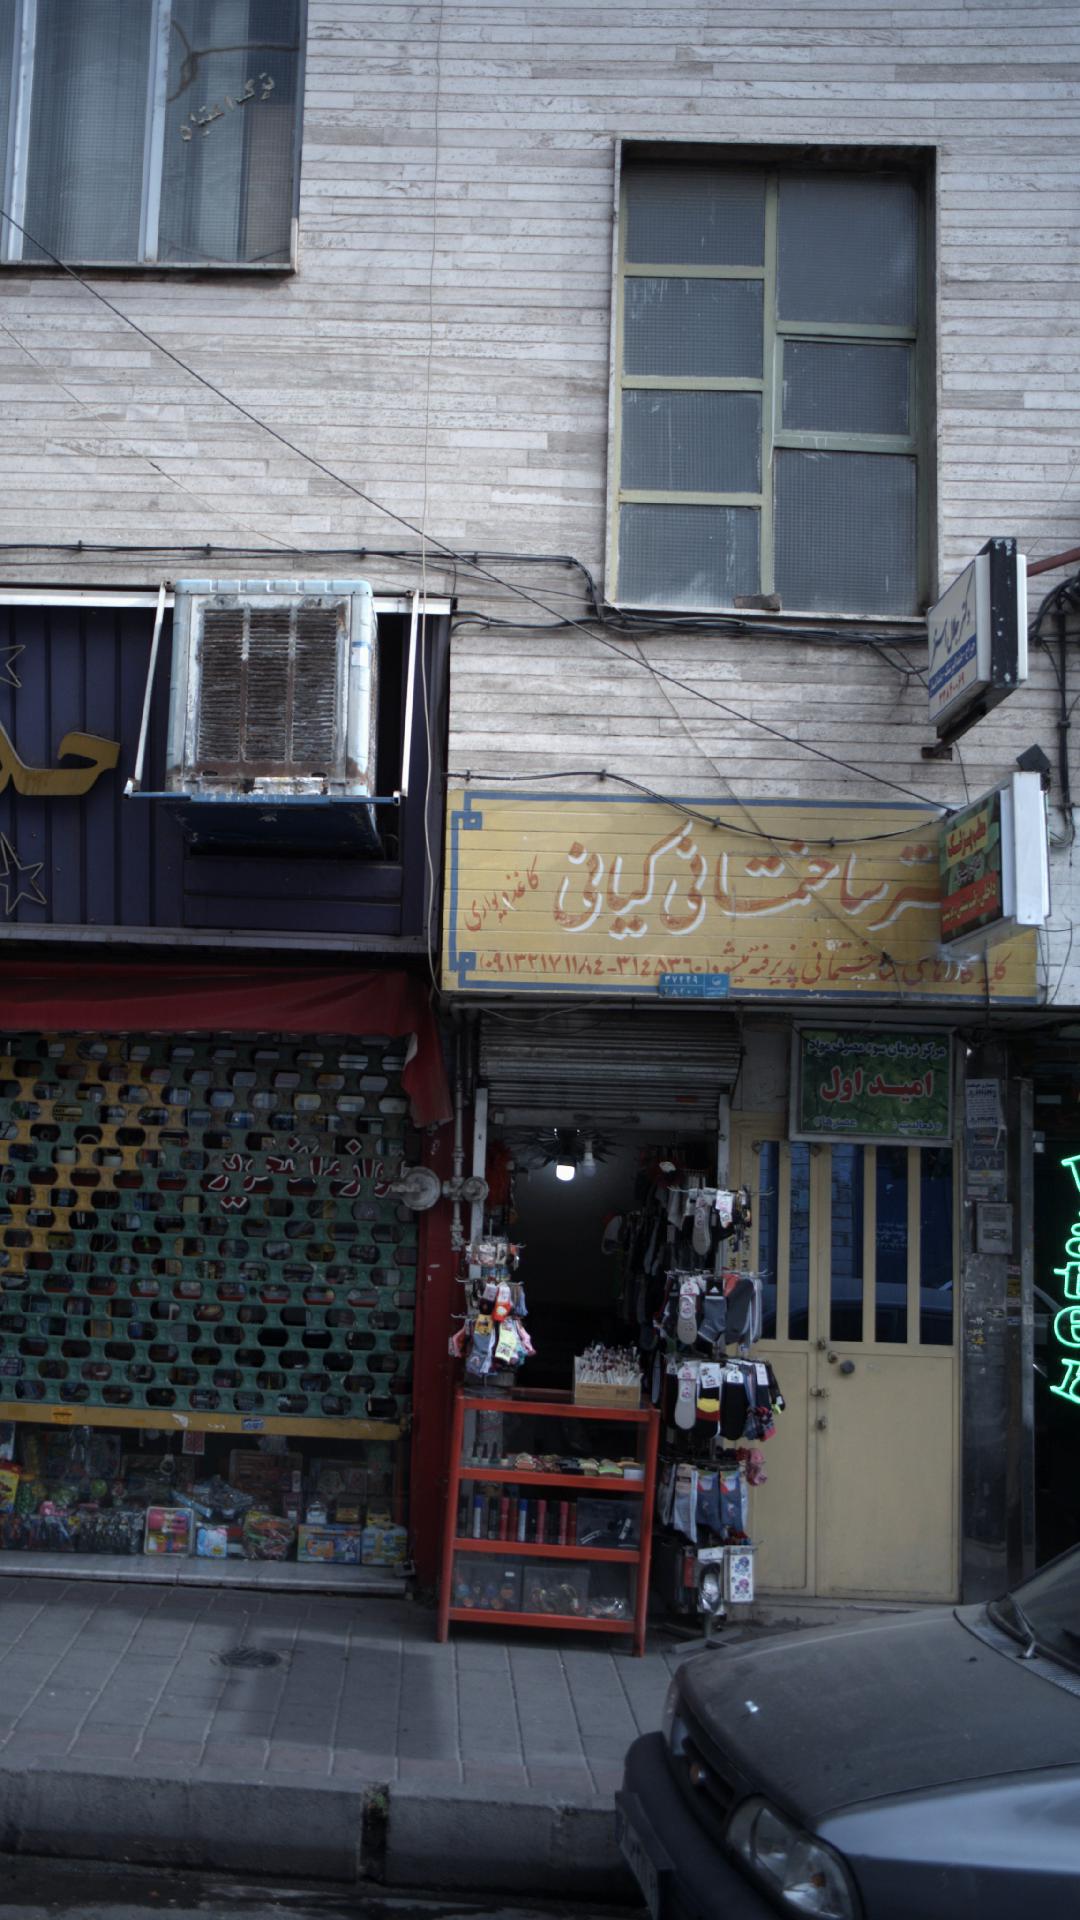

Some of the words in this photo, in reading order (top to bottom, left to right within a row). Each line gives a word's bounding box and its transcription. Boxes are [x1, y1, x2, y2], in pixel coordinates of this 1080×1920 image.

[553, 819, 695, 940] کیانی
[660, 836, 890, 936] ساختمانی
[887, 1039, 920, 1059] درمان
[920, 1041, 947, 1060] مرکز
[820, 1065, 864, 1103] اول
[867, 1069, 934, 1104] امید
